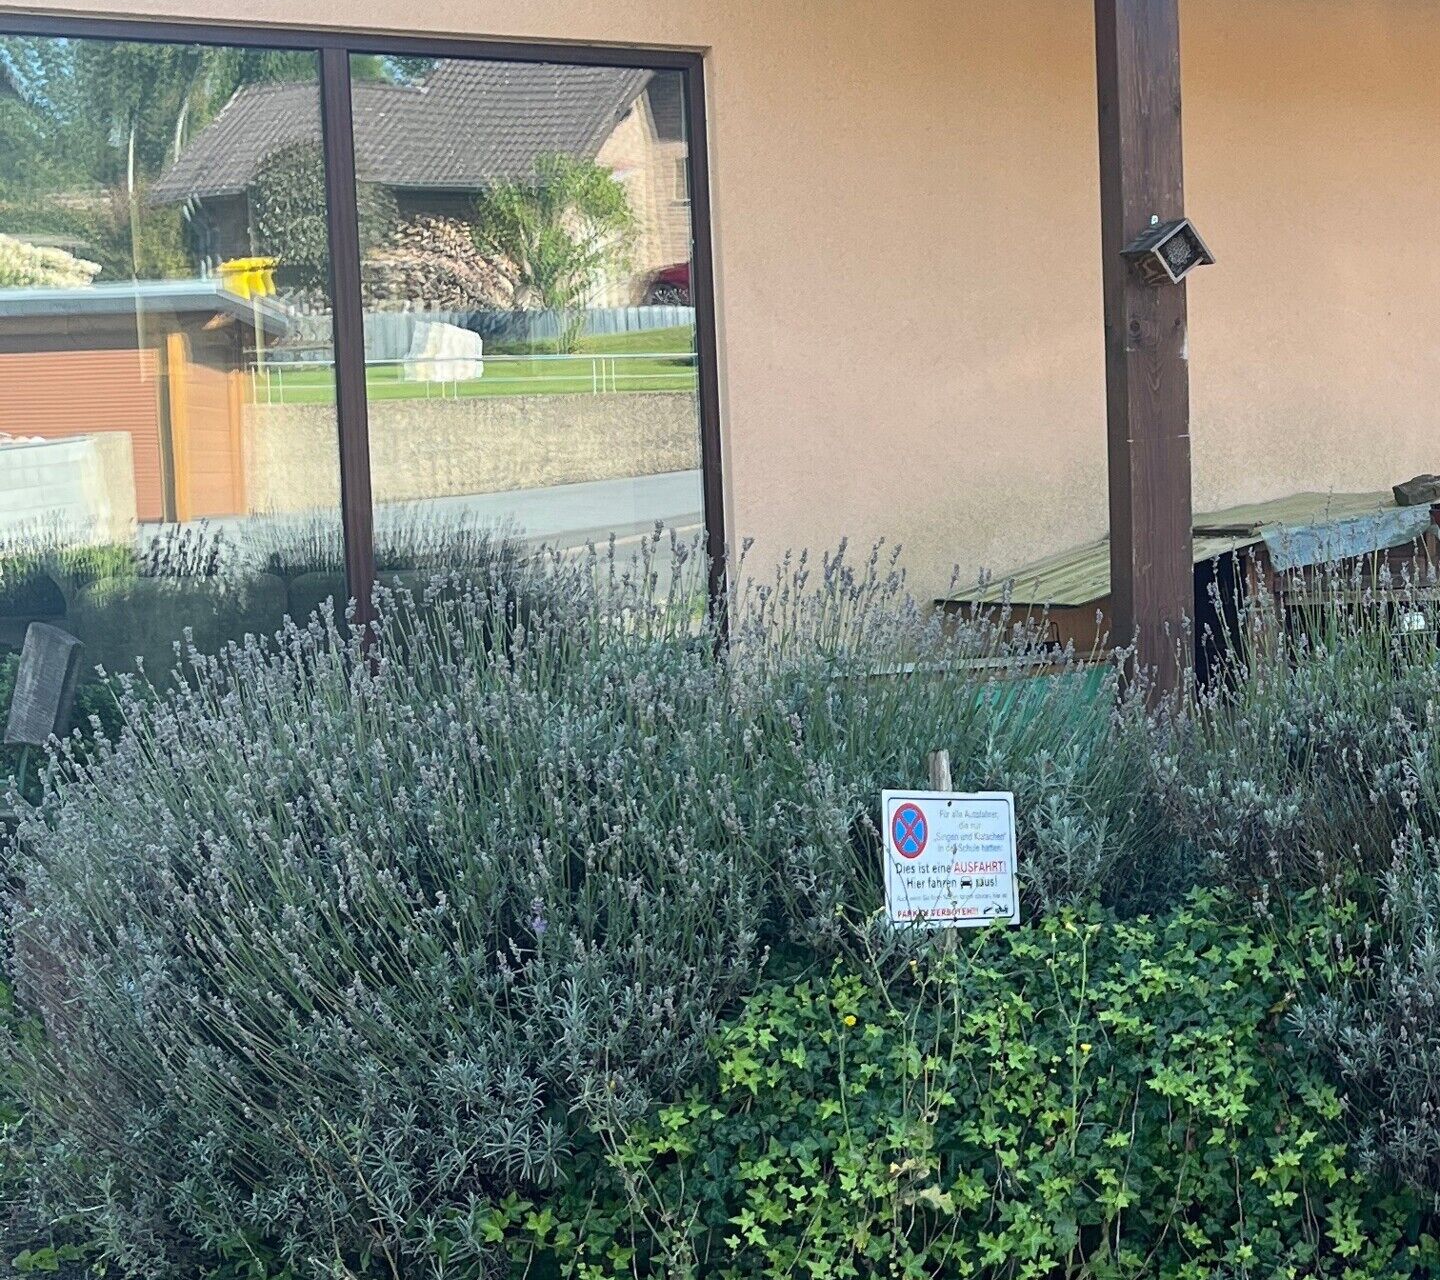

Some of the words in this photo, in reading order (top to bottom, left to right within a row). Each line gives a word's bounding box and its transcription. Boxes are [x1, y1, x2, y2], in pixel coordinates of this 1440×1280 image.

[896, 862, 916, 874] Dies
[918, 863, 931, 873] ist
[932, 863, 952, 873] eine
[953, 860, 1008, 874] AUSFAHRT!
[907, 878, 926, 889] Hier
[928, 877, 957, 889] fahren
